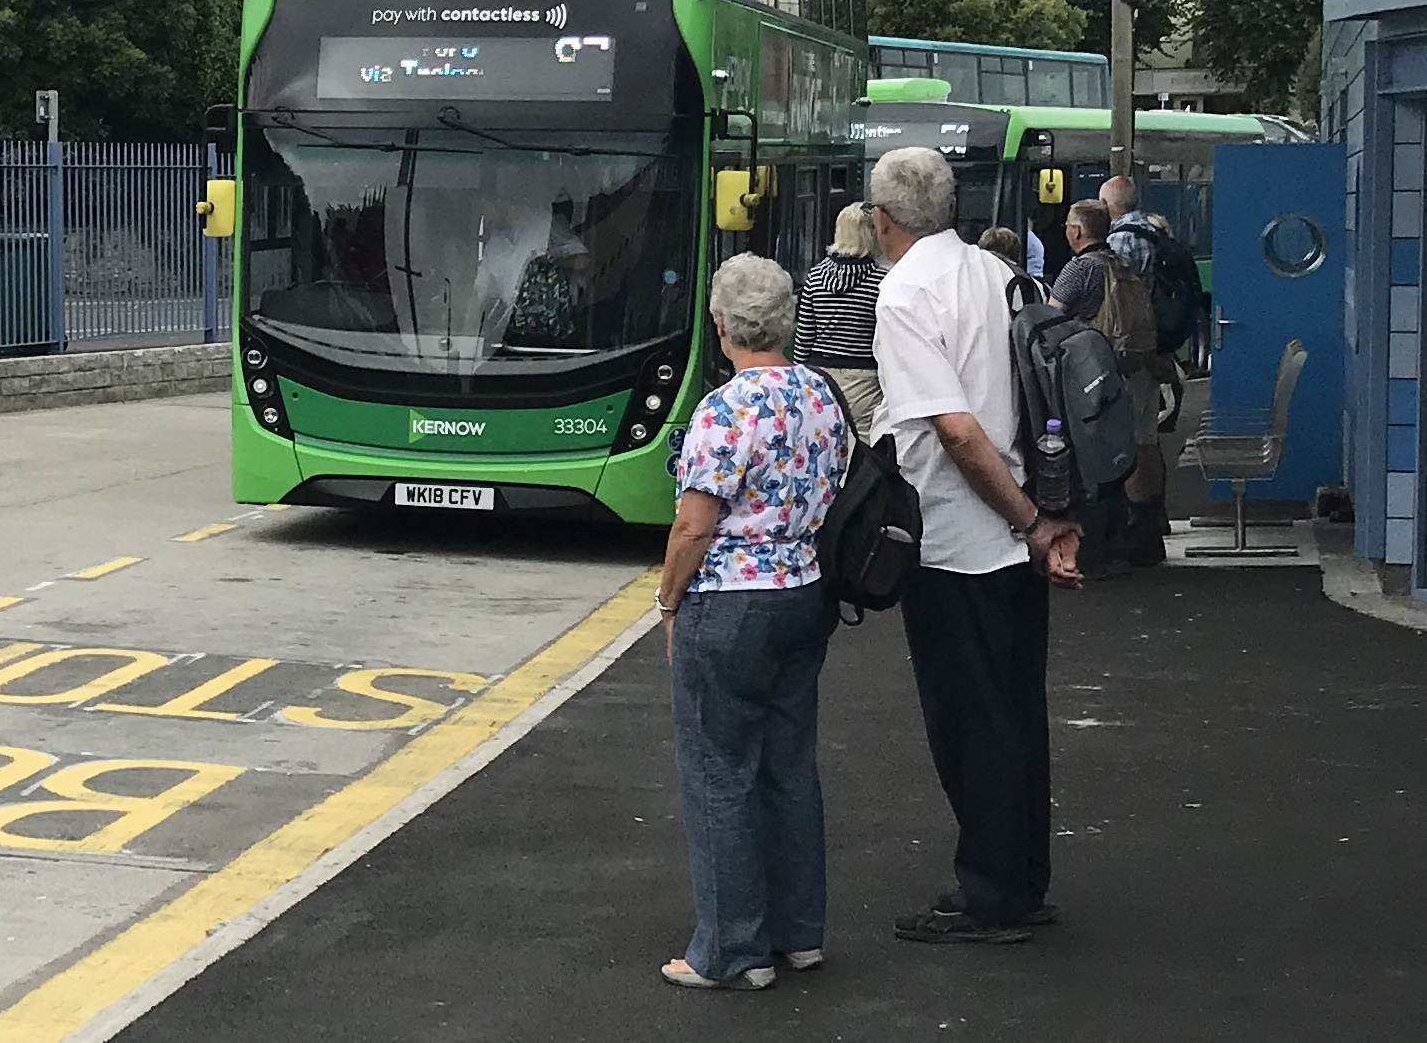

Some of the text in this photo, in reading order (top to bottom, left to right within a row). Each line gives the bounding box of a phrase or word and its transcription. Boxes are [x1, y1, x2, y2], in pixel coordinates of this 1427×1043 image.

[371, 6, 540, 25] pay with contactless
[412, 418, 486, 437] KERNOW
[554, 418, 608, 435] 33304
[406, 486, 482, 507] WK18 CFV
